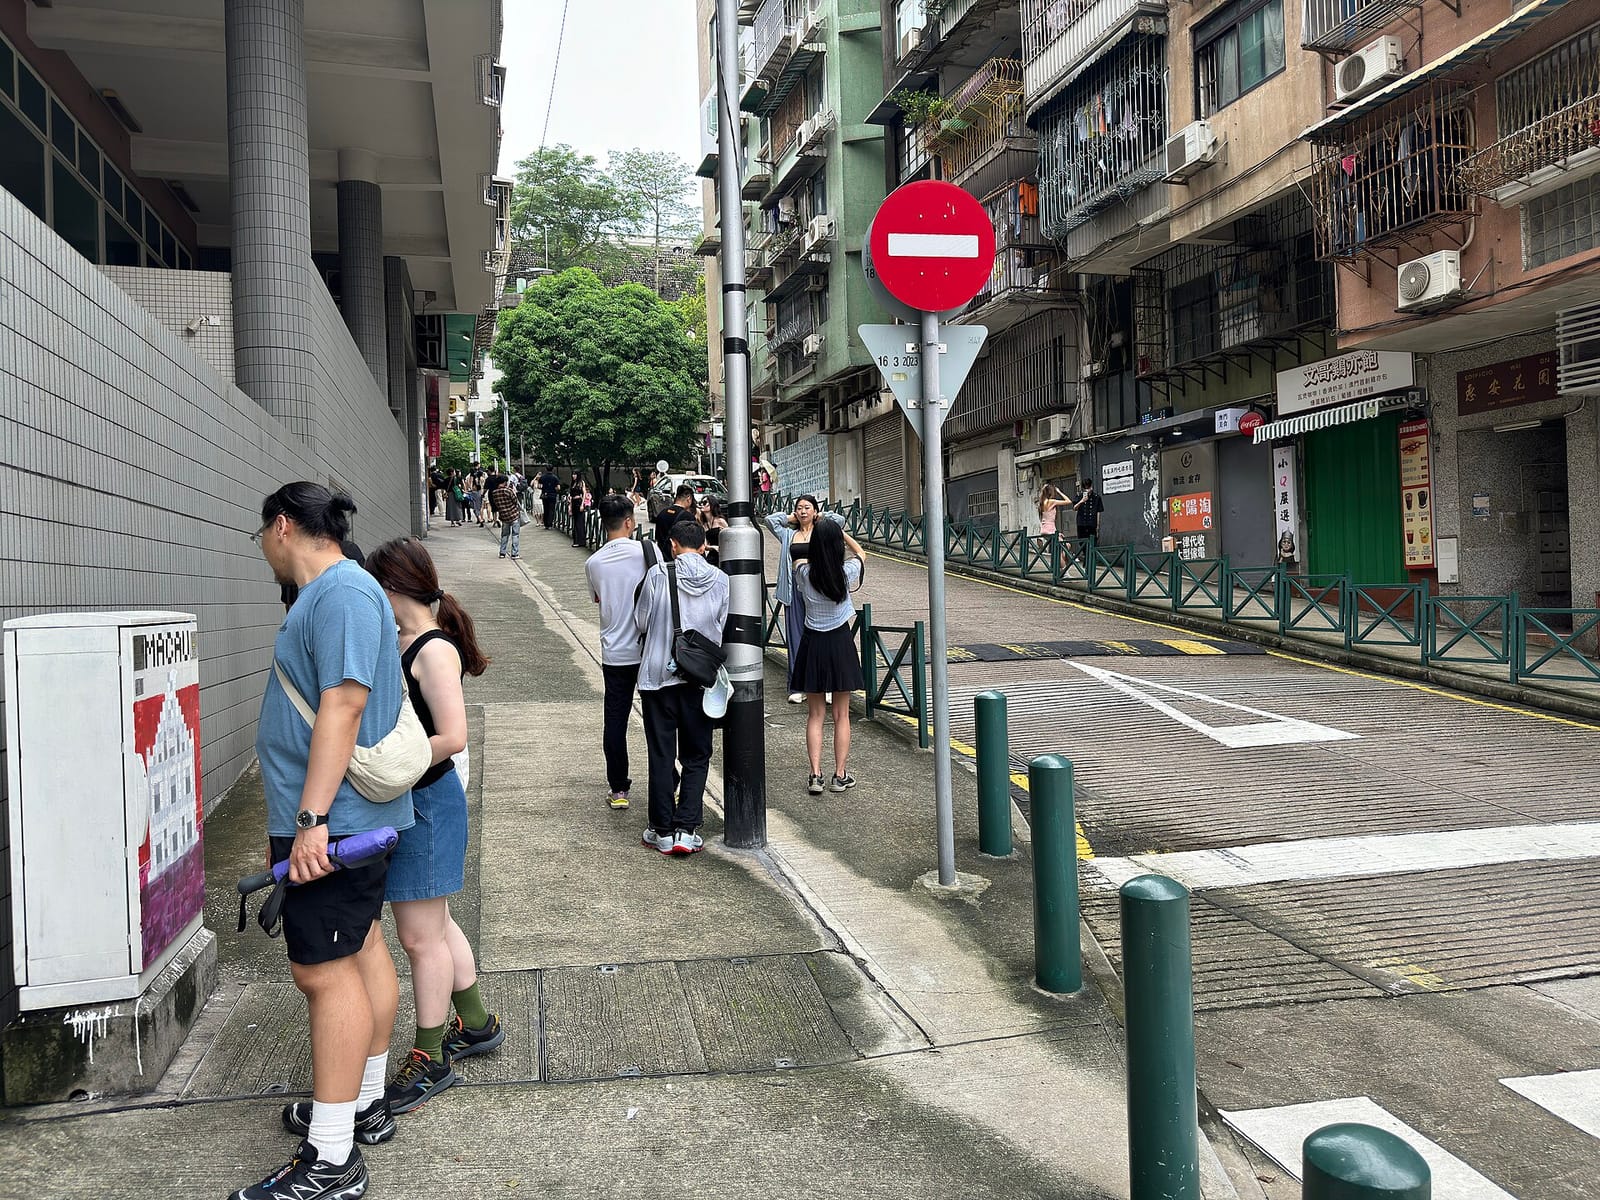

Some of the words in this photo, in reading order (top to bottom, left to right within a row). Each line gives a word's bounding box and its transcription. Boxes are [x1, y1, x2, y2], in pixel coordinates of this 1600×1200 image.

[865, 267, 875, 279] 18
[878, 356, 888, 367] 16
[893, 356, 899, 367] 3
[902, 356, 919, 367] 2023
[144, 630, 190, 669] MACAU
